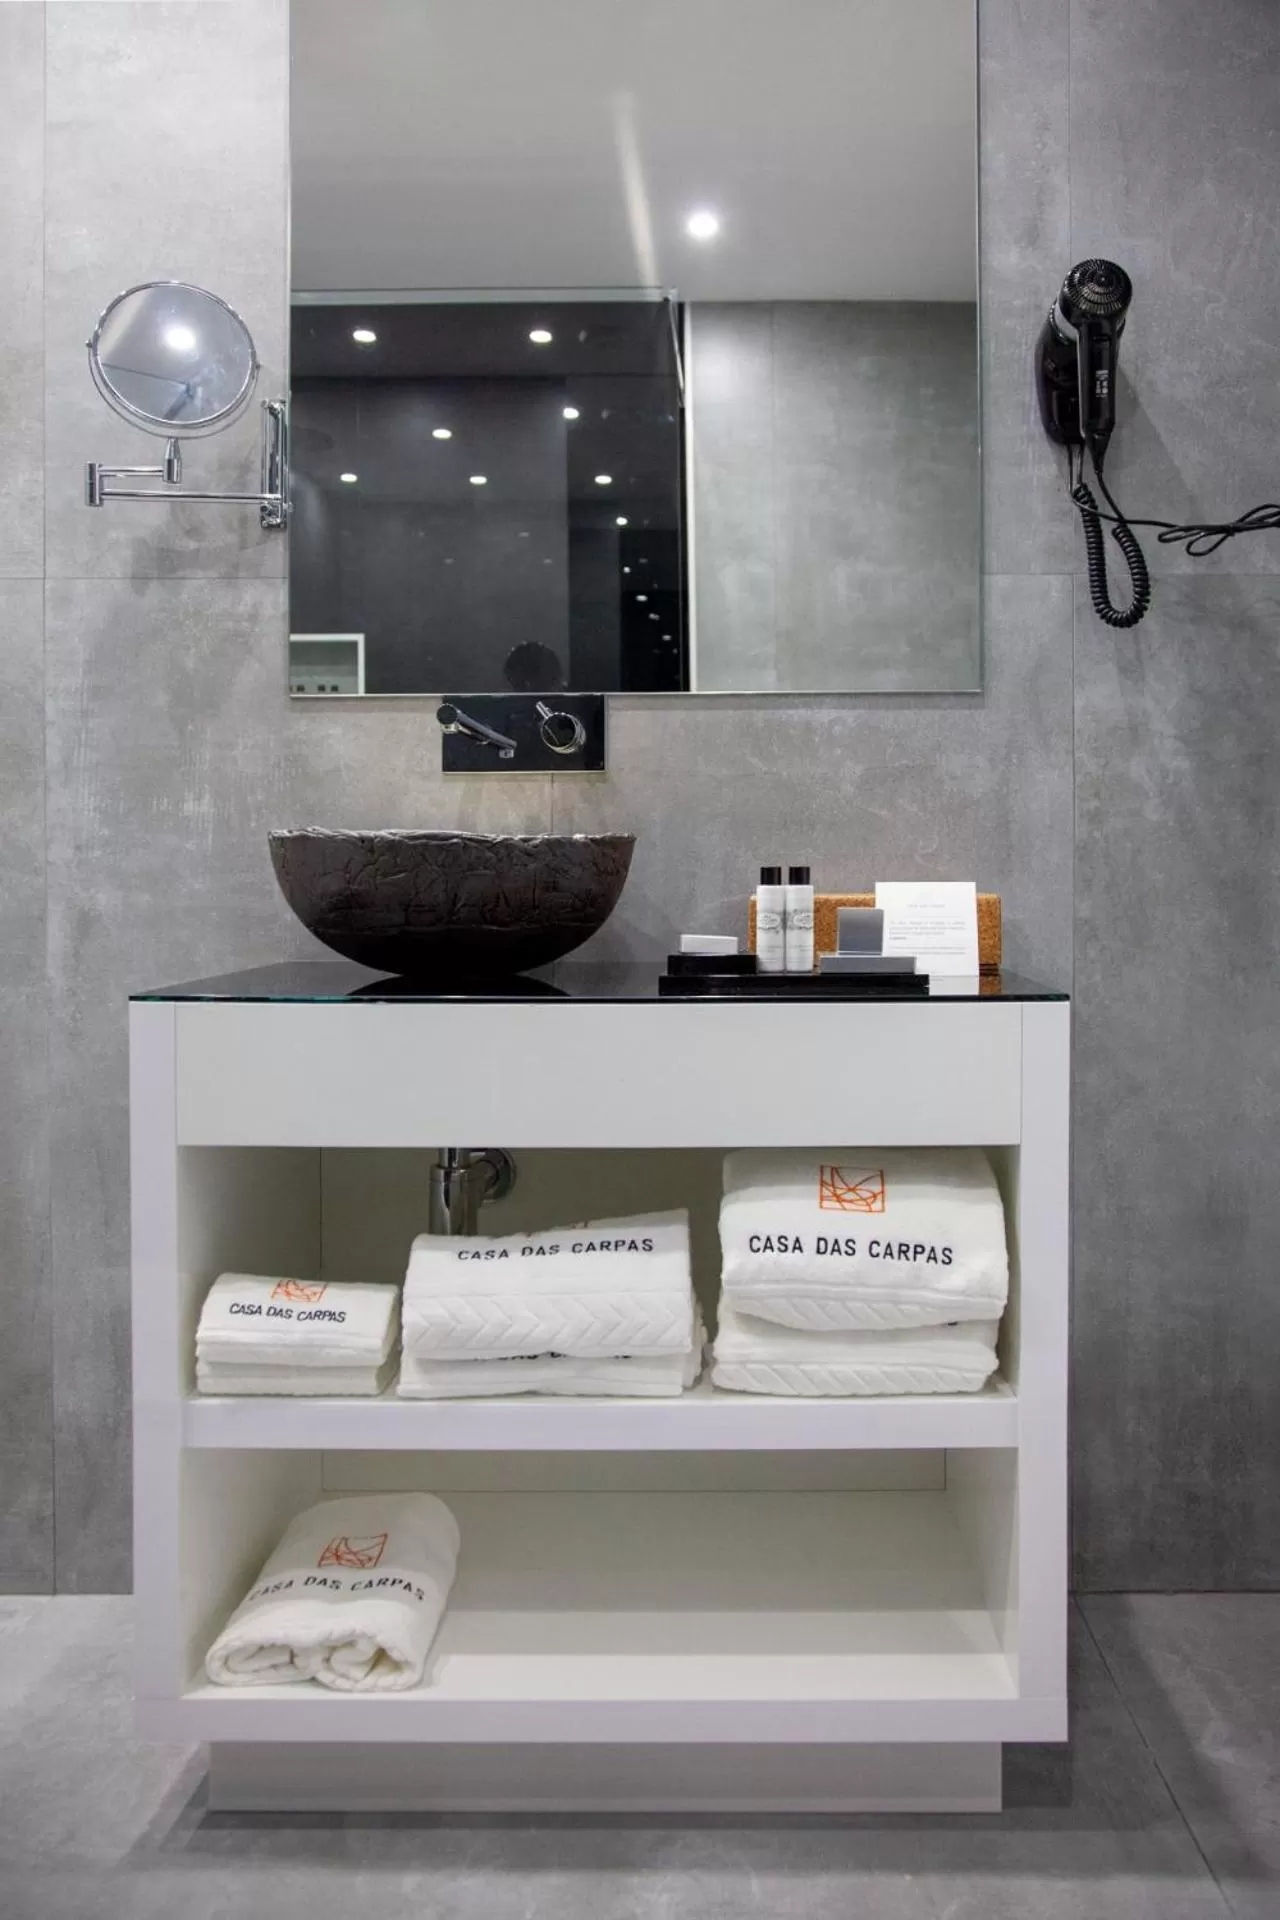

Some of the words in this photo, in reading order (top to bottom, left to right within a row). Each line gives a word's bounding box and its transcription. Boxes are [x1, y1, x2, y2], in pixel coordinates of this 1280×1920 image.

[457, 1249, 509, 1261] CASA
[521, 1244, 561, 1257] DAS
[571, 1239, 655, 1254] CARPAS
[749, 1235, 804, 1254] CASA
[816, 1237, 857, 1257] DAS
[868, 1240, 954, 1265] CARPAS
[229, 1303, 262, 1316] CASA
[266, 1306, 294, 1319] DAS
[296, 1310, 347, 1323] CARPAS
[303, 1576, 343, 1591] DAS
[350, 1577, 425, 1601] CARPAS
